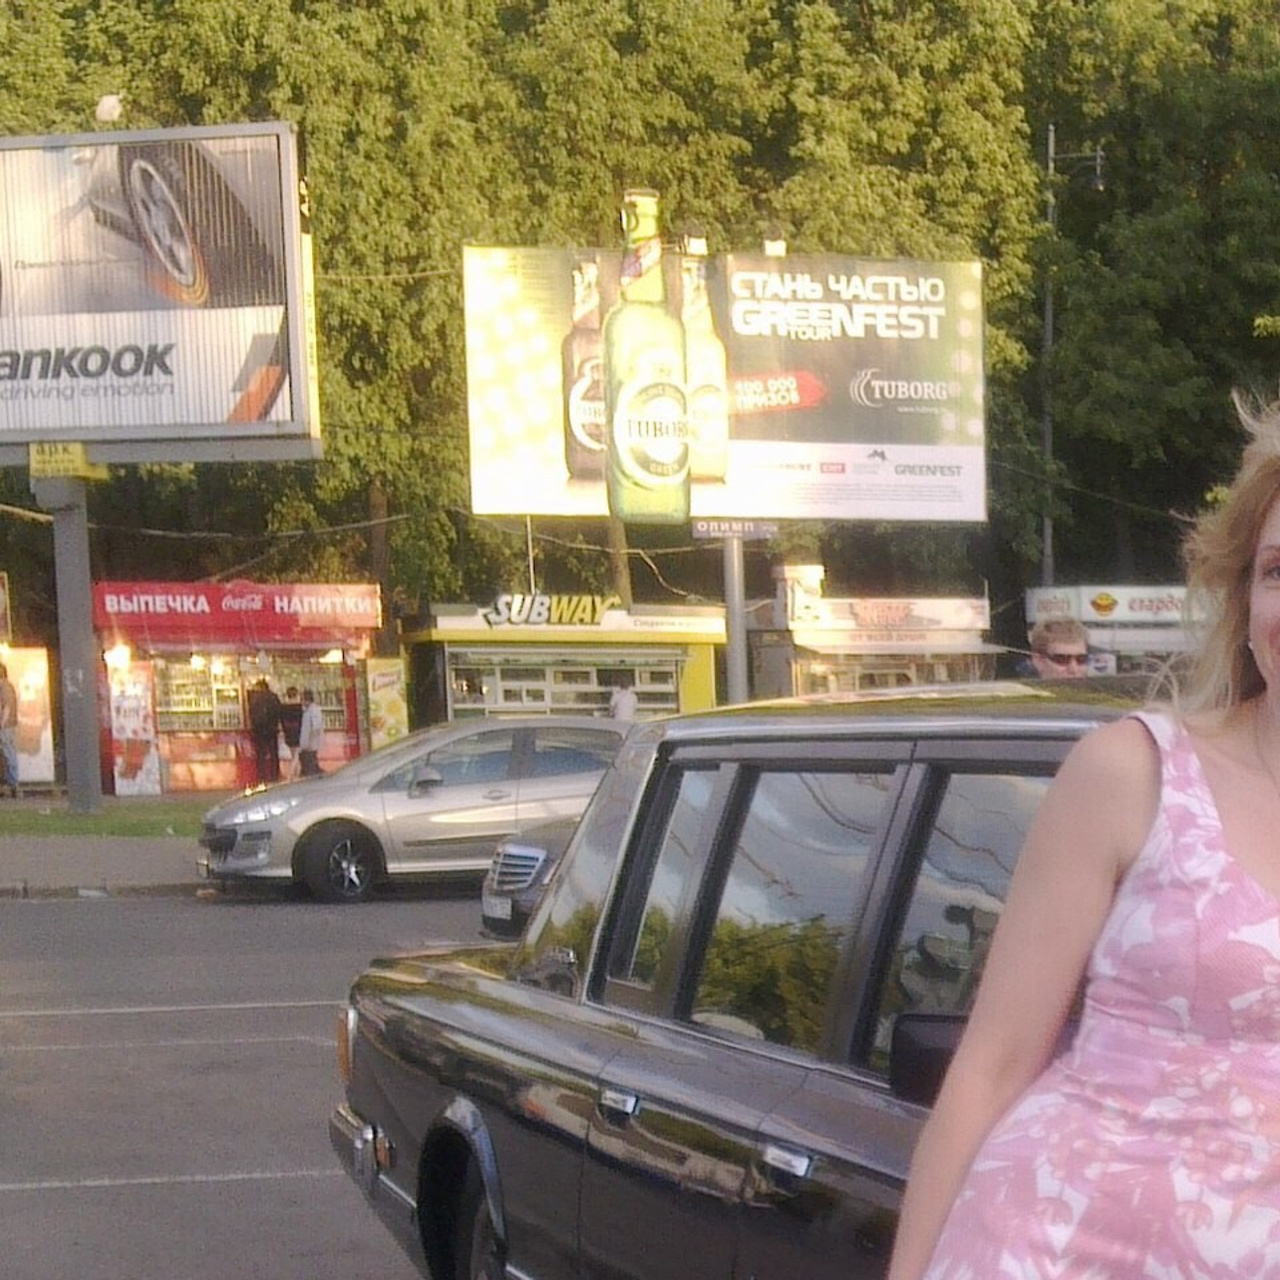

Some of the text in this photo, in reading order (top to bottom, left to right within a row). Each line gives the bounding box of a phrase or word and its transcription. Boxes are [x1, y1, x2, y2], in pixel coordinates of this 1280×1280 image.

[731, 271, 945, 302] СТАНЬ ЧАСТЬЮ
[1, 382, 174, 400] driving emotion
[871, 380, 948, 400] TUBORG
[697, 521, 754, 532] ОЛИМП
[105, 594, 210, 614] ВЫПЕЧКА
[274, 596, 372, 614] НАПИТКИ
[484, 593, 621, 627] SUBWAY
